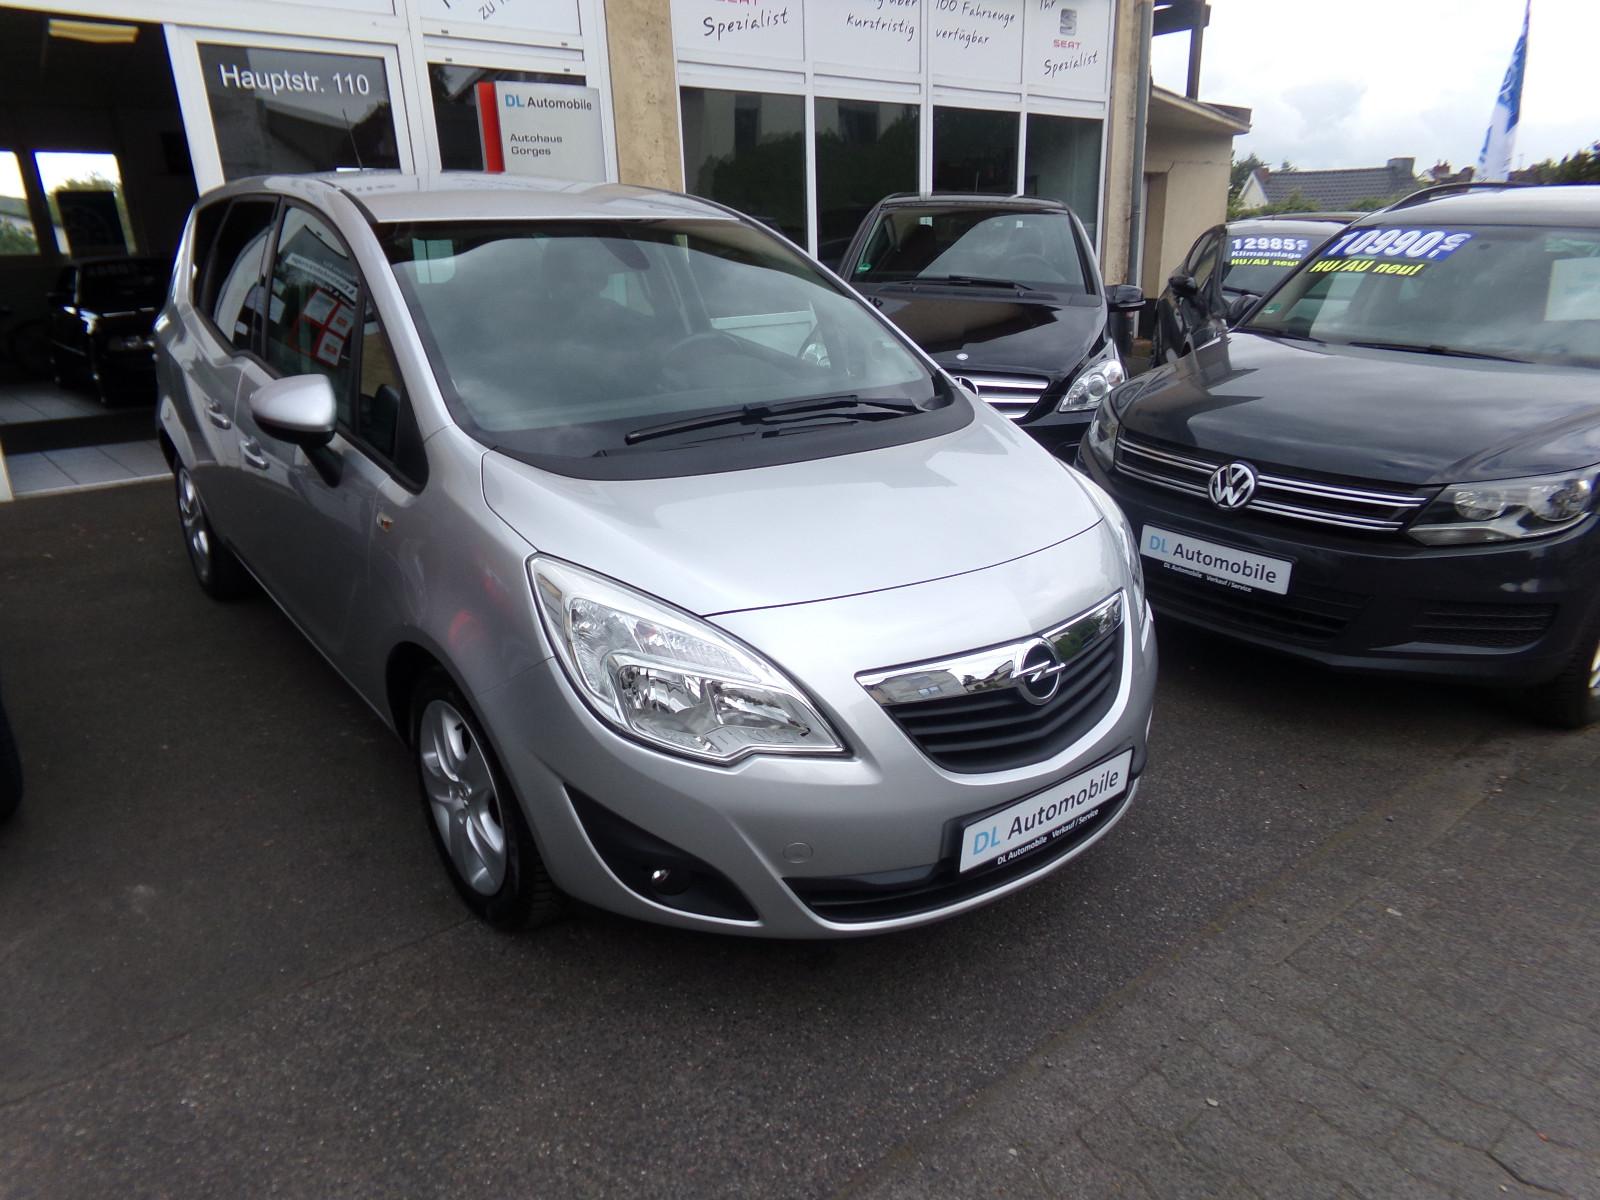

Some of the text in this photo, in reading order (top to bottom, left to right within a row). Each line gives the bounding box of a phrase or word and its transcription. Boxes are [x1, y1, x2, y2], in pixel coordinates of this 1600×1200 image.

[703, 7, 788, 40] Spezialist
[962, 1, 1015, 28] Fahrzeuge
[936, 27, 990, 48] verfügbar
[1053, 40, 1080, 48] SEAT
[1044, 50, 1098, 78] Spezialist
[219, 64, 370, 95] Hauptstr. 110
[505, 94, 592, 110] DL Automobile
[510, 133, 563, 143] Autohaus
[511, 146, 551, 157] Gorges
[1231, 251, 1302, 259] Klimaanlage
[1309, 260, 1425, 275] HU/AU neu!
[1150, 535, 1277, 583] DL Automobile
[973, 770, 1119, 855] DL Automobile
[996, 854, 1007, 865] DL
[1008, 836, 1048, 860] Automobile
[1052, 821, 1076, 838] Verkauf
[1079, 808, 1099, 825] Service
